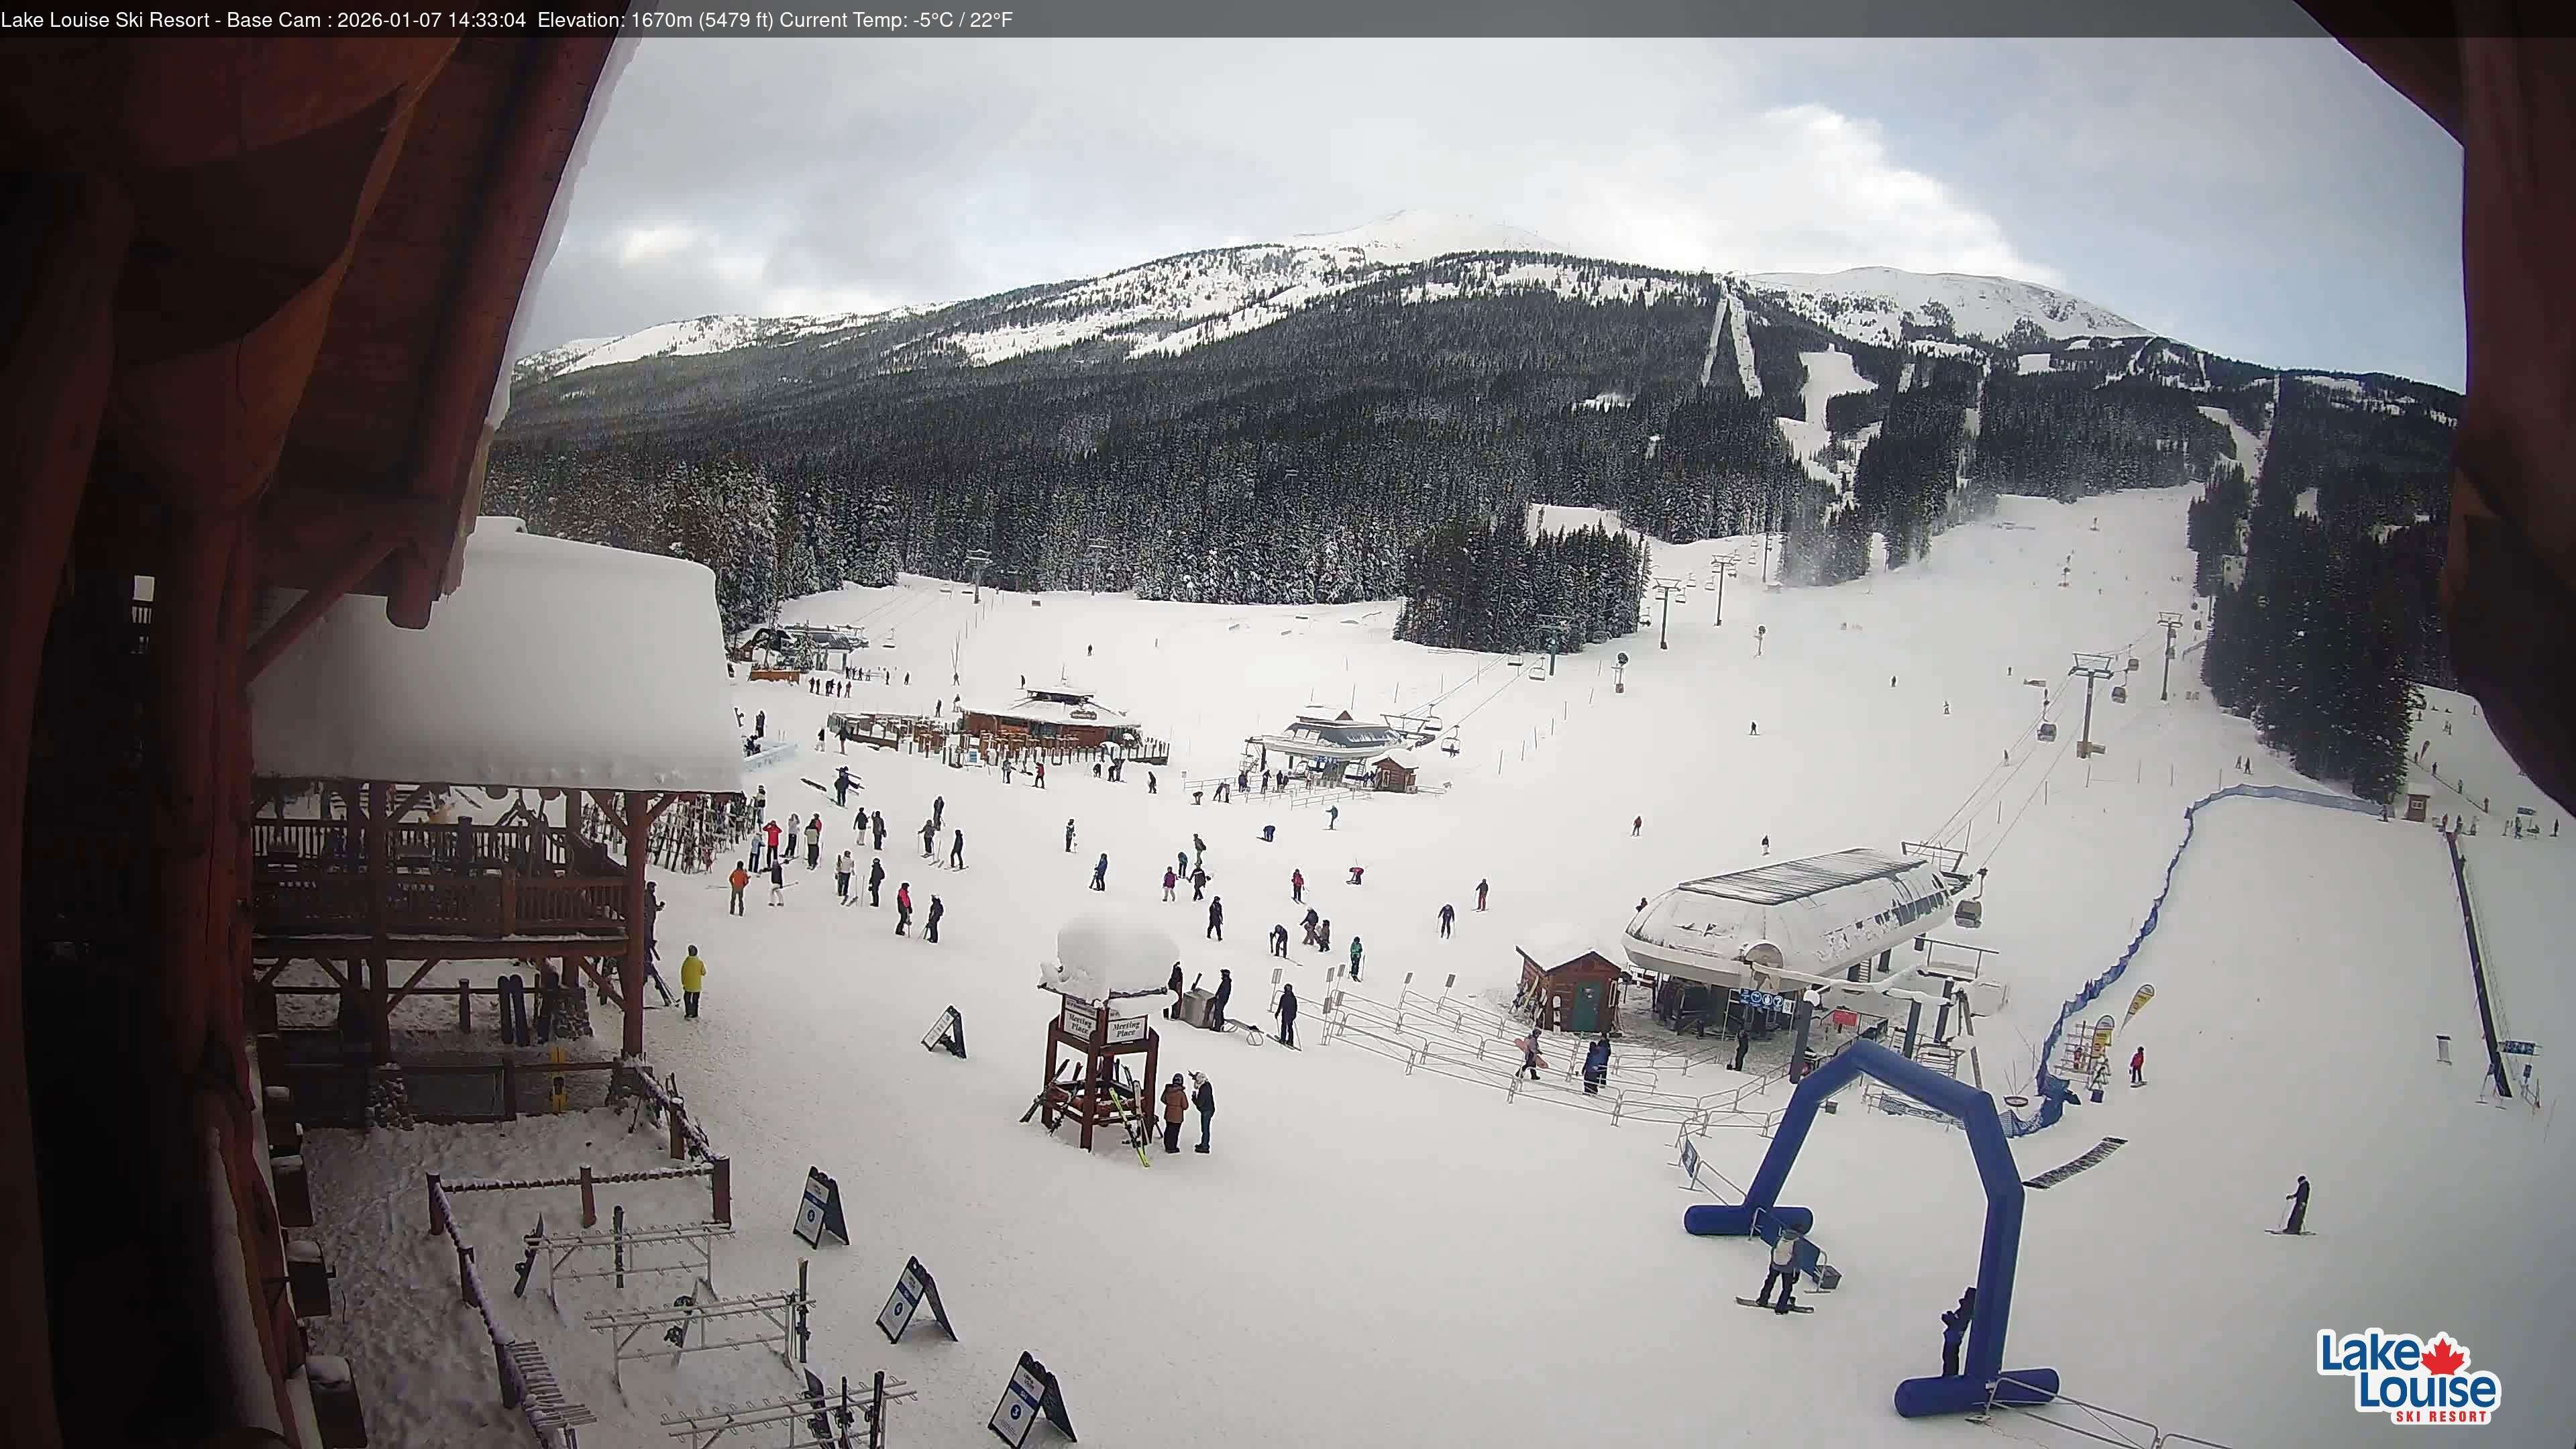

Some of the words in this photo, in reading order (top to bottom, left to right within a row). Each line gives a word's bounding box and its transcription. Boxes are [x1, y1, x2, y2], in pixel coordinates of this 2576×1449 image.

[1069, 1013, 1092, 1029] Meeting
[1112, 1020, 1140, 1031] Meeting
[1071, 1022, 1089, 1034] Place
[1116, 1030, 1136, 1038] Place
